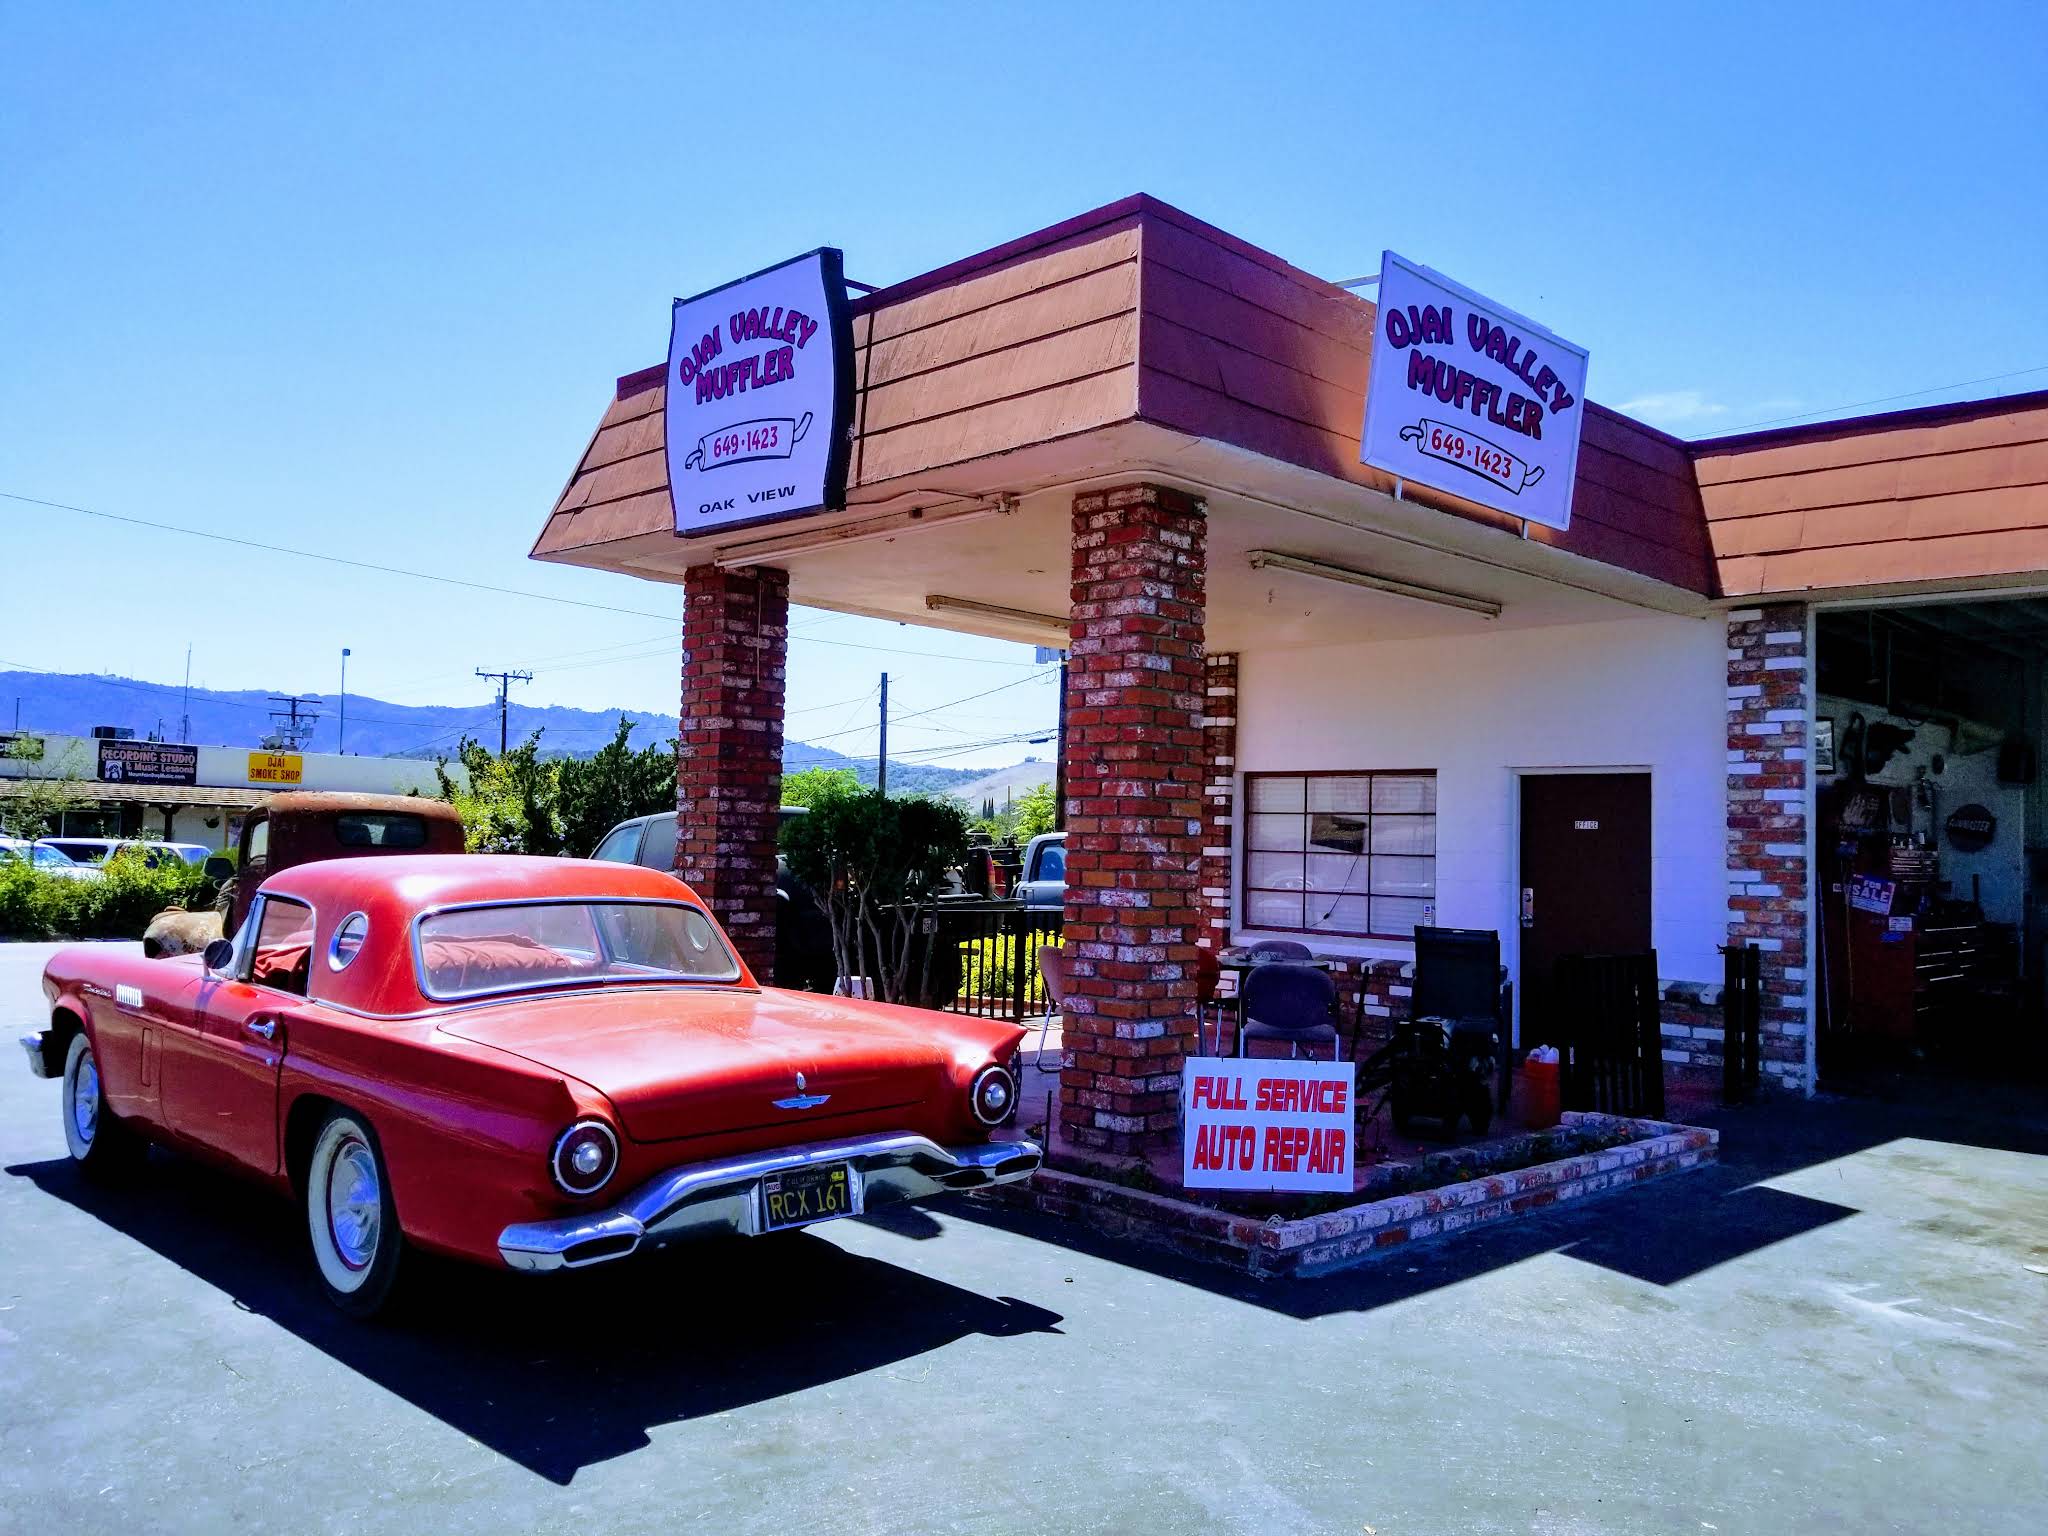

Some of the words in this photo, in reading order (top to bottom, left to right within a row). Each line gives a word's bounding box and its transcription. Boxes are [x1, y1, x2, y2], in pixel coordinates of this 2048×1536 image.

[680, 325, 722, 386] OJAI
[730, 306, 818, 349] VALLEY
[1386, 304, 1454, 349] OJAI
[1467, 313, 1575, 415] VALLEY
[696, 345, 795, 405] MUFFLER
[1407, 348, 1544, 440] MUFFLER
[699, 498, 735, 514] OAK
[747, 485, 796, 503] VIEW
[101, 749, 157, 761] RECORDING
[160, 753, 195, 764] STUDIO
[134, 763, 159, 772] Music
[161, 764, 194, 774] Lessons
[267, 757, 285, 768] OJAI
[250, 768, 277, 779] SMOKE
[280, 769, 300, 781] SHOP
[1575, 821, 1598, 829] OFFICE
[1852, 885, 1890, 902] SALE
[1863, 880, 1881, 890] FOR
[1192, 1076, 1248, 1111] FULL
[1255, 1078, 1347, 1114] SERVICE
[1192, 1124, 1256, 1171] AUTO
[1262, 1126, 1346, 1174] REPAIR
[769, 1189, 810, 1220] RCX
[816, 1183, 845, 1212] 167
